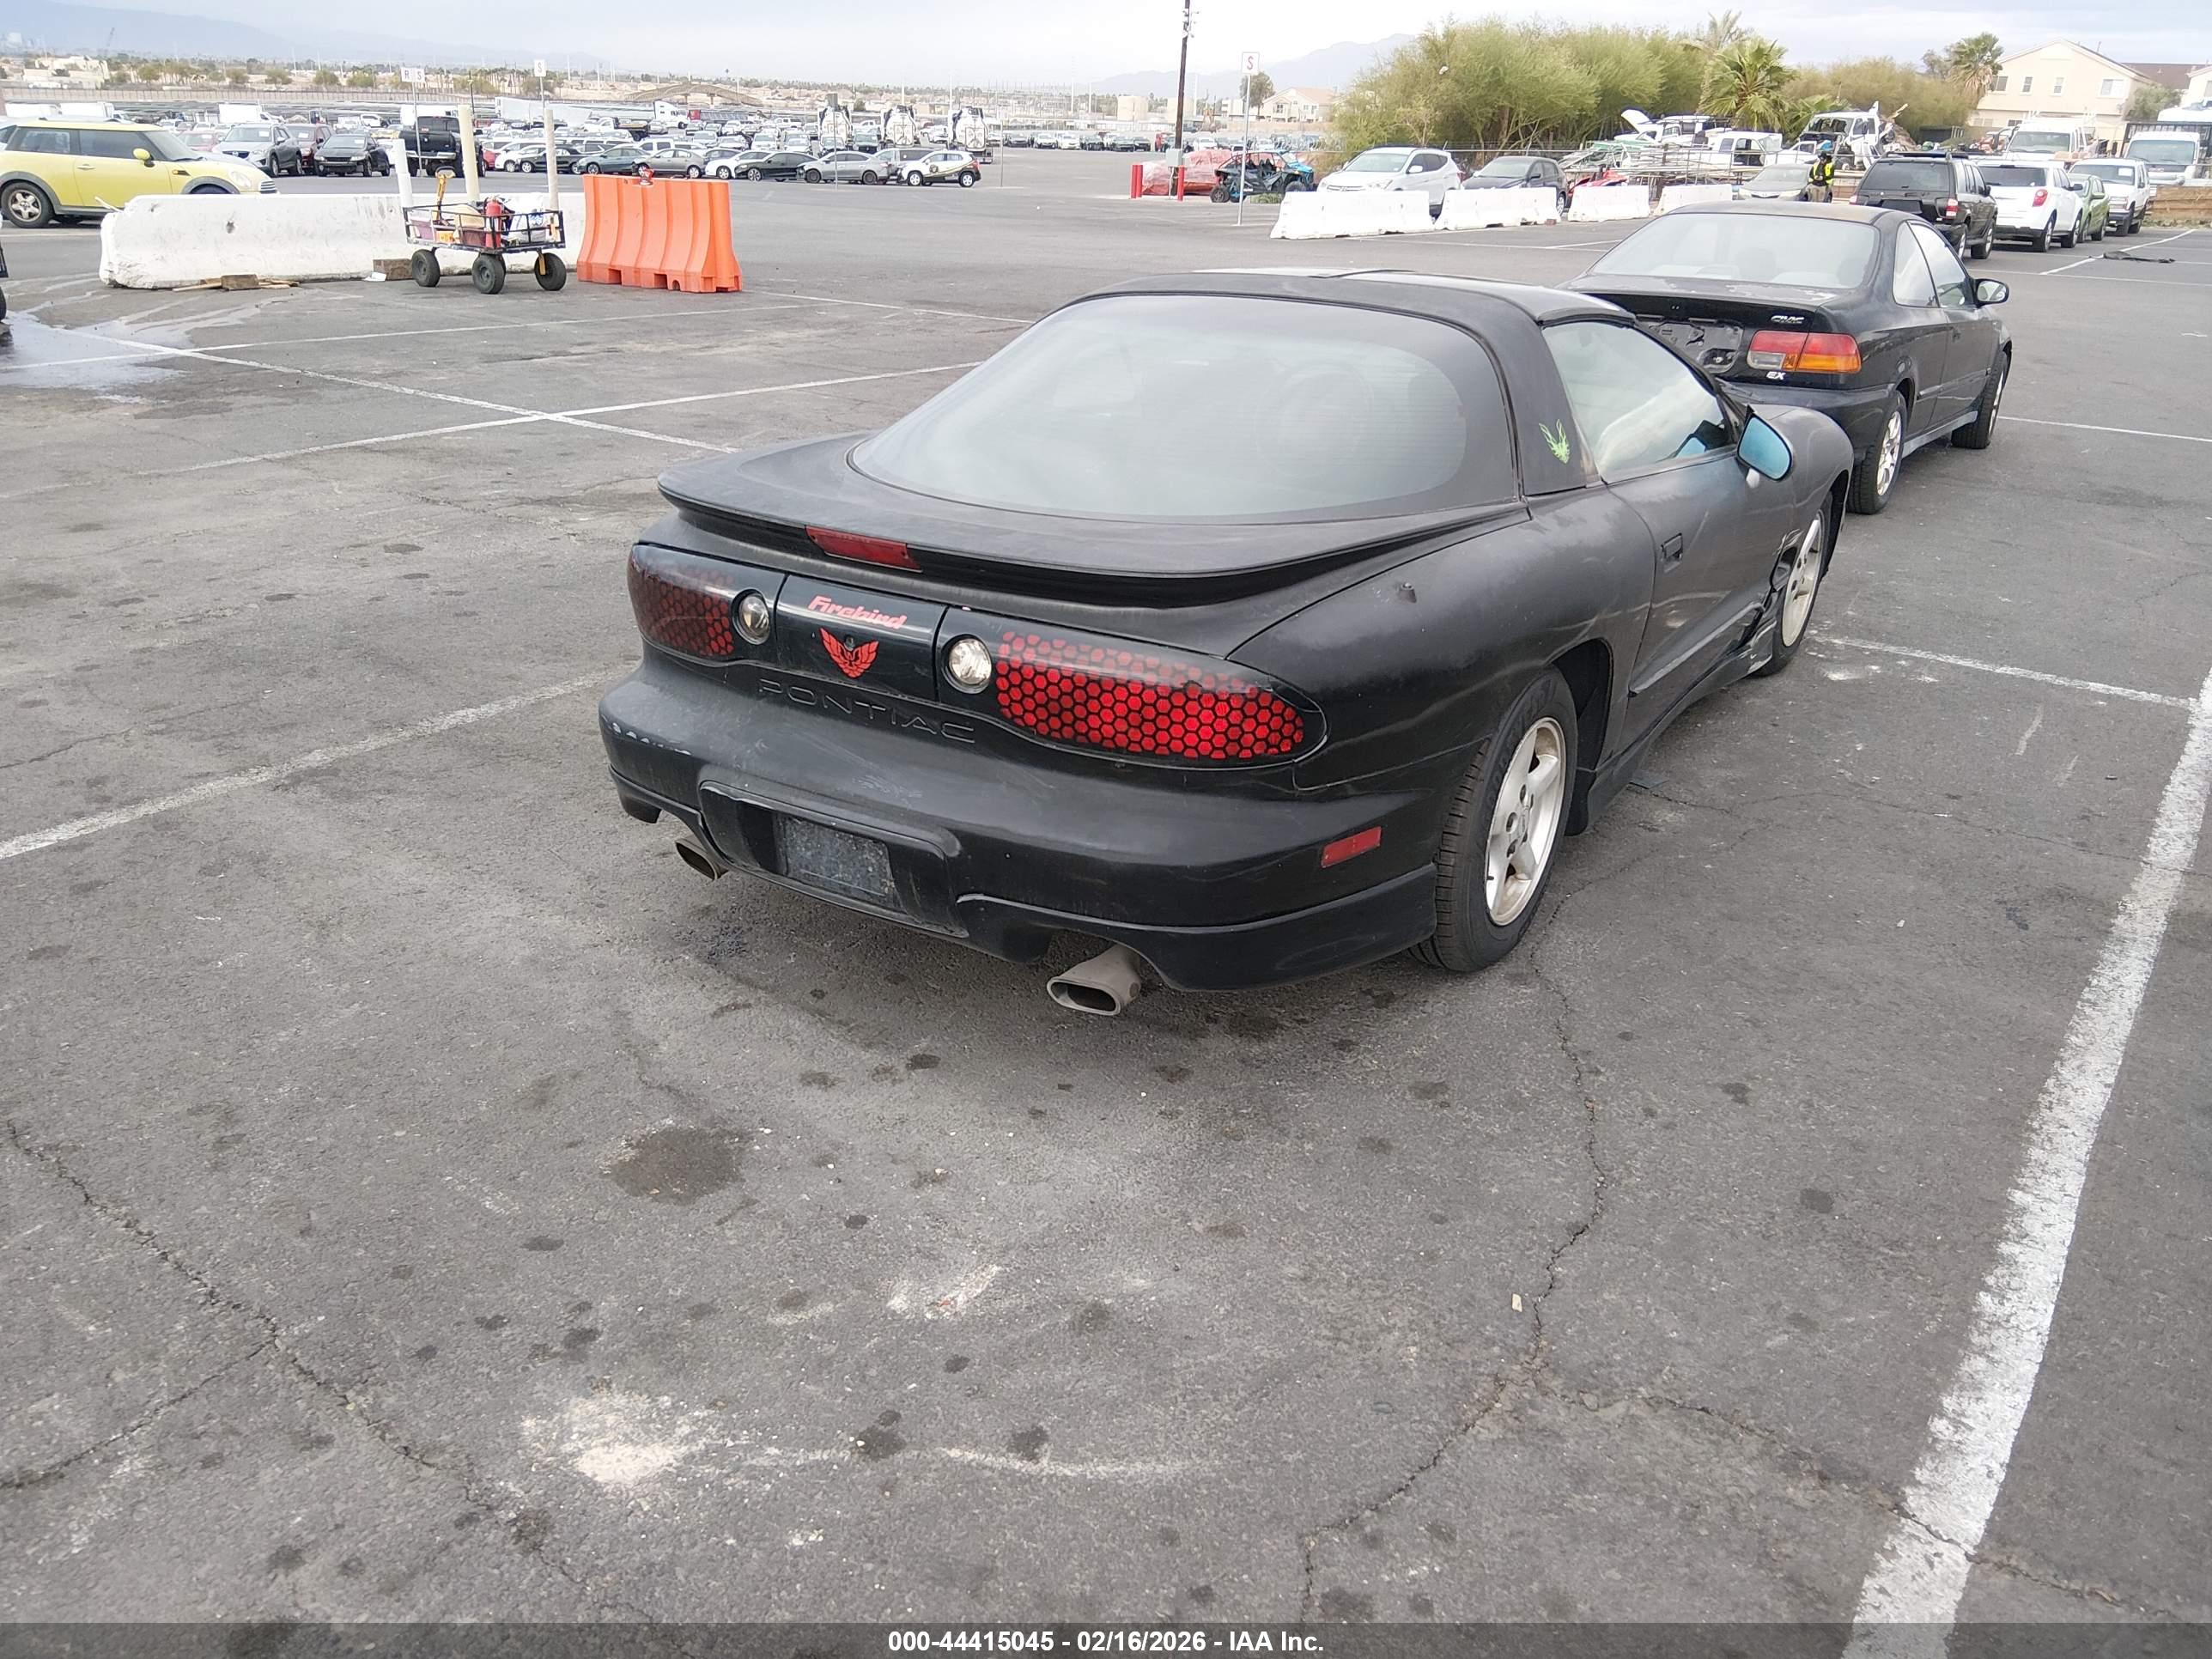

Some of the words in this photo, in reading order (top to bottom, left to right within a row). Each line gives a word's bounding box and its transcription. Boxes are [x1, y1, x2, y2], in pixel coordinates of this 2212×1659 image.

[1247, 55, 1254, 70] S
[1766, 371, 1786, 380] EX
[808, 595, 908, 629] Firebird
[757, 678, 975, 744] PONTIAC
